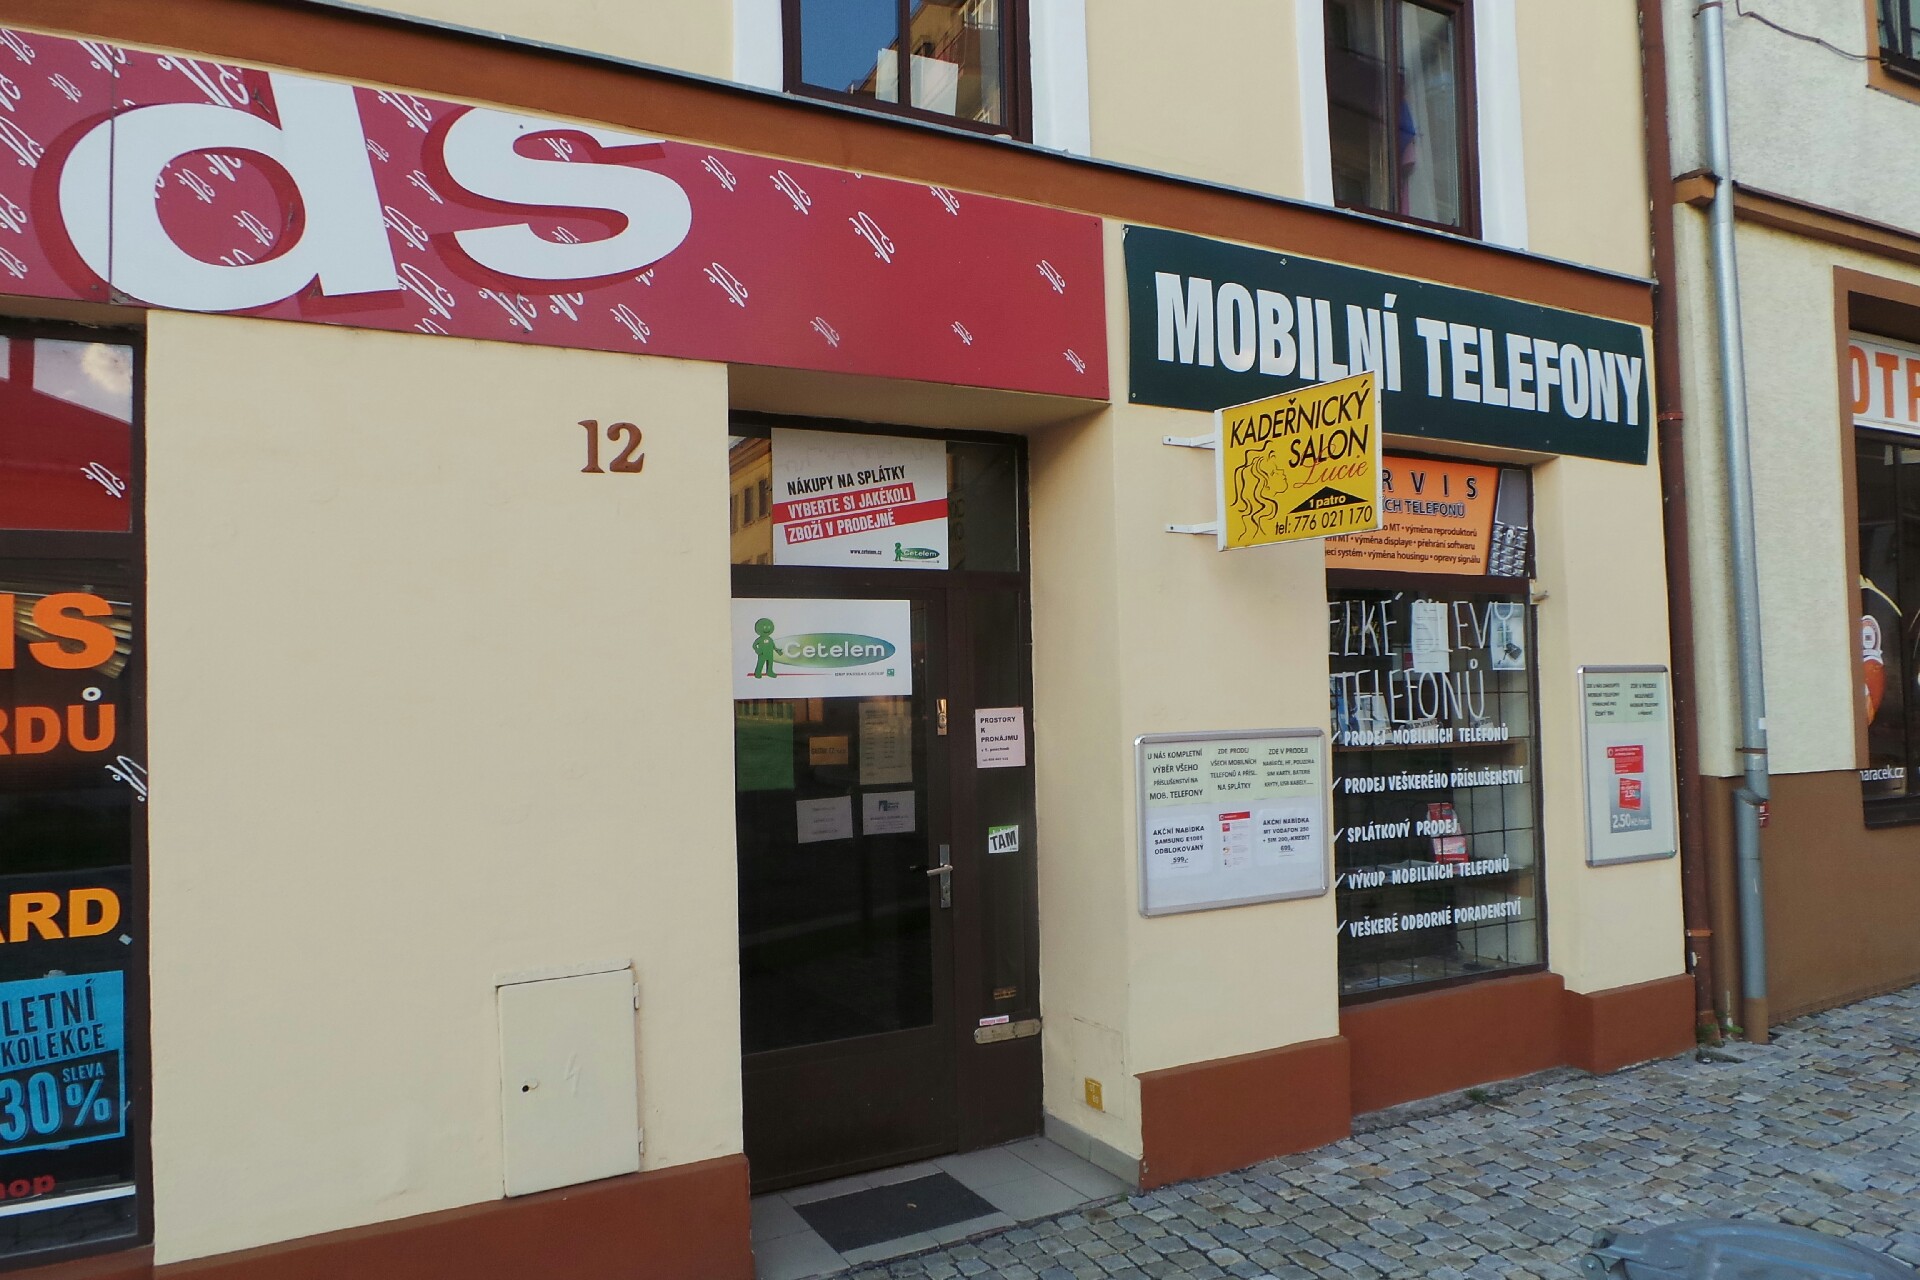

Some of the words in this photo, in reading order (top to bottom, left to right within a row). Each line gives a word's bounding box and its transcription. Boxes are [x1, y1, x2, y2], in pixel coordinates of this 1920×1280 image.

[1155, 271, 1401, 391] MOBILNÍ
[1417, 317, 1643, 426] TELEFONY
[1230, 379, 1371, 448] KADEŘNICKÝ
[577, 420, 646, 474] 12
[1289, 424, 1369, 468] SALON
[1293, 443, 1368, 488] Lucie
[787, 475, 834, 495] NÁKUPY
[837, 472, 855, 488] NA
[858, 465, 905, 485] SPLÁTKY
[788, 498, 841, 519] VYBERTE
[844, 494, 856, 510] SI
[858, 486, 911, 507] JAKÉKOLI
[1310, 499, 1315, 508] 1
[1316, 495, 1347, 509] patro
[788, 520, 823, 543] ZBOŽÍ
[825, 521, 834, 536] V
[837, 508, 896, 533] PRODEJNĚ
[1275, 516, 1292, 535] tel:
[1294, 514, 1318, 532] 776
[1321, 509, 1344, 528] 021
[1349, 505, 1373, 524] 170
[1405, 524, 1433, 534] výměna
[1434, 528, 1477, 537] reproduktorů
[1355, 535, 1382, 545] výměna
[1417, 539, 1446, 549] přehrání
[903, 550, 937, 558] Cetelem
[1338, 549, 1363, 558] systém
[1367, 550, 1395, 560] výměna
[1397, 551, 1429, 562] housingu
[1434, 554, 1456, 564] opravy
[783, 641, 885, 659] Cetelem
[1330, 658, 1484, 726] TELEFONŮ
[1344, 729, 1386, 746] PRODEJ
[1393, 725, 1453, 744] MOBILNÍCH
[1458, 723, 1509, 742] TELEFONŮ
[1153, 750, 1166, 759] NÁS
[1167, 748, 1203, 759] KOMPLETNÍ
[1152, 764, 1174, 773] VÝBĚR
[1175, 763, 1199, 772] VŠEHO
[1210, 769, 1236, 778] TELEFONŮ
[1345, 777, 1386, 794] PRODEJ
[1388, 770, 1448, 791] VEŠKERÉHO
[1450, 765, 1524, 787] PŘÍSLUŠENSTVÍ
[1153, 777, 1189, 786] PŘÍSLUŠENSTVÍ
[1227, 781, 1251, 790] SPLÁTKY
[1170, 788, 1203, 799] TELEFONY
[990, 831, 1017, 851] TAM
[1153, 827, 1174, 836] AKČNÍ
[1175, 824, 1204, 834] NABÍDKA
[1154, 837, 1185, 845] SAMSUNG
[1347, 819, 1411, 842] SPLÁTKOVÝ
[1416, 818, 1457, 836] PRODEJ
[1348, 869, 1386, 890] VÝKUP
[1392, 861, 1454, 884] MOBILNÍCH
[1459, 854, 1510, 877] TELEFONŮ
[1350, 913, 1399, 938] VEŠKERÉ
[1401, 906, 1451, 931] ODBORNÉ
[1454, 897, 1522, 923] PORADENSTVÍ
[3, 979, 97, 1037] LETNÍ
[2, 1024, 105, 1069] KOLEKCE
[62, 1062, 105, 1083] SLEVA
[0, 1072, 60, 1142] 30
